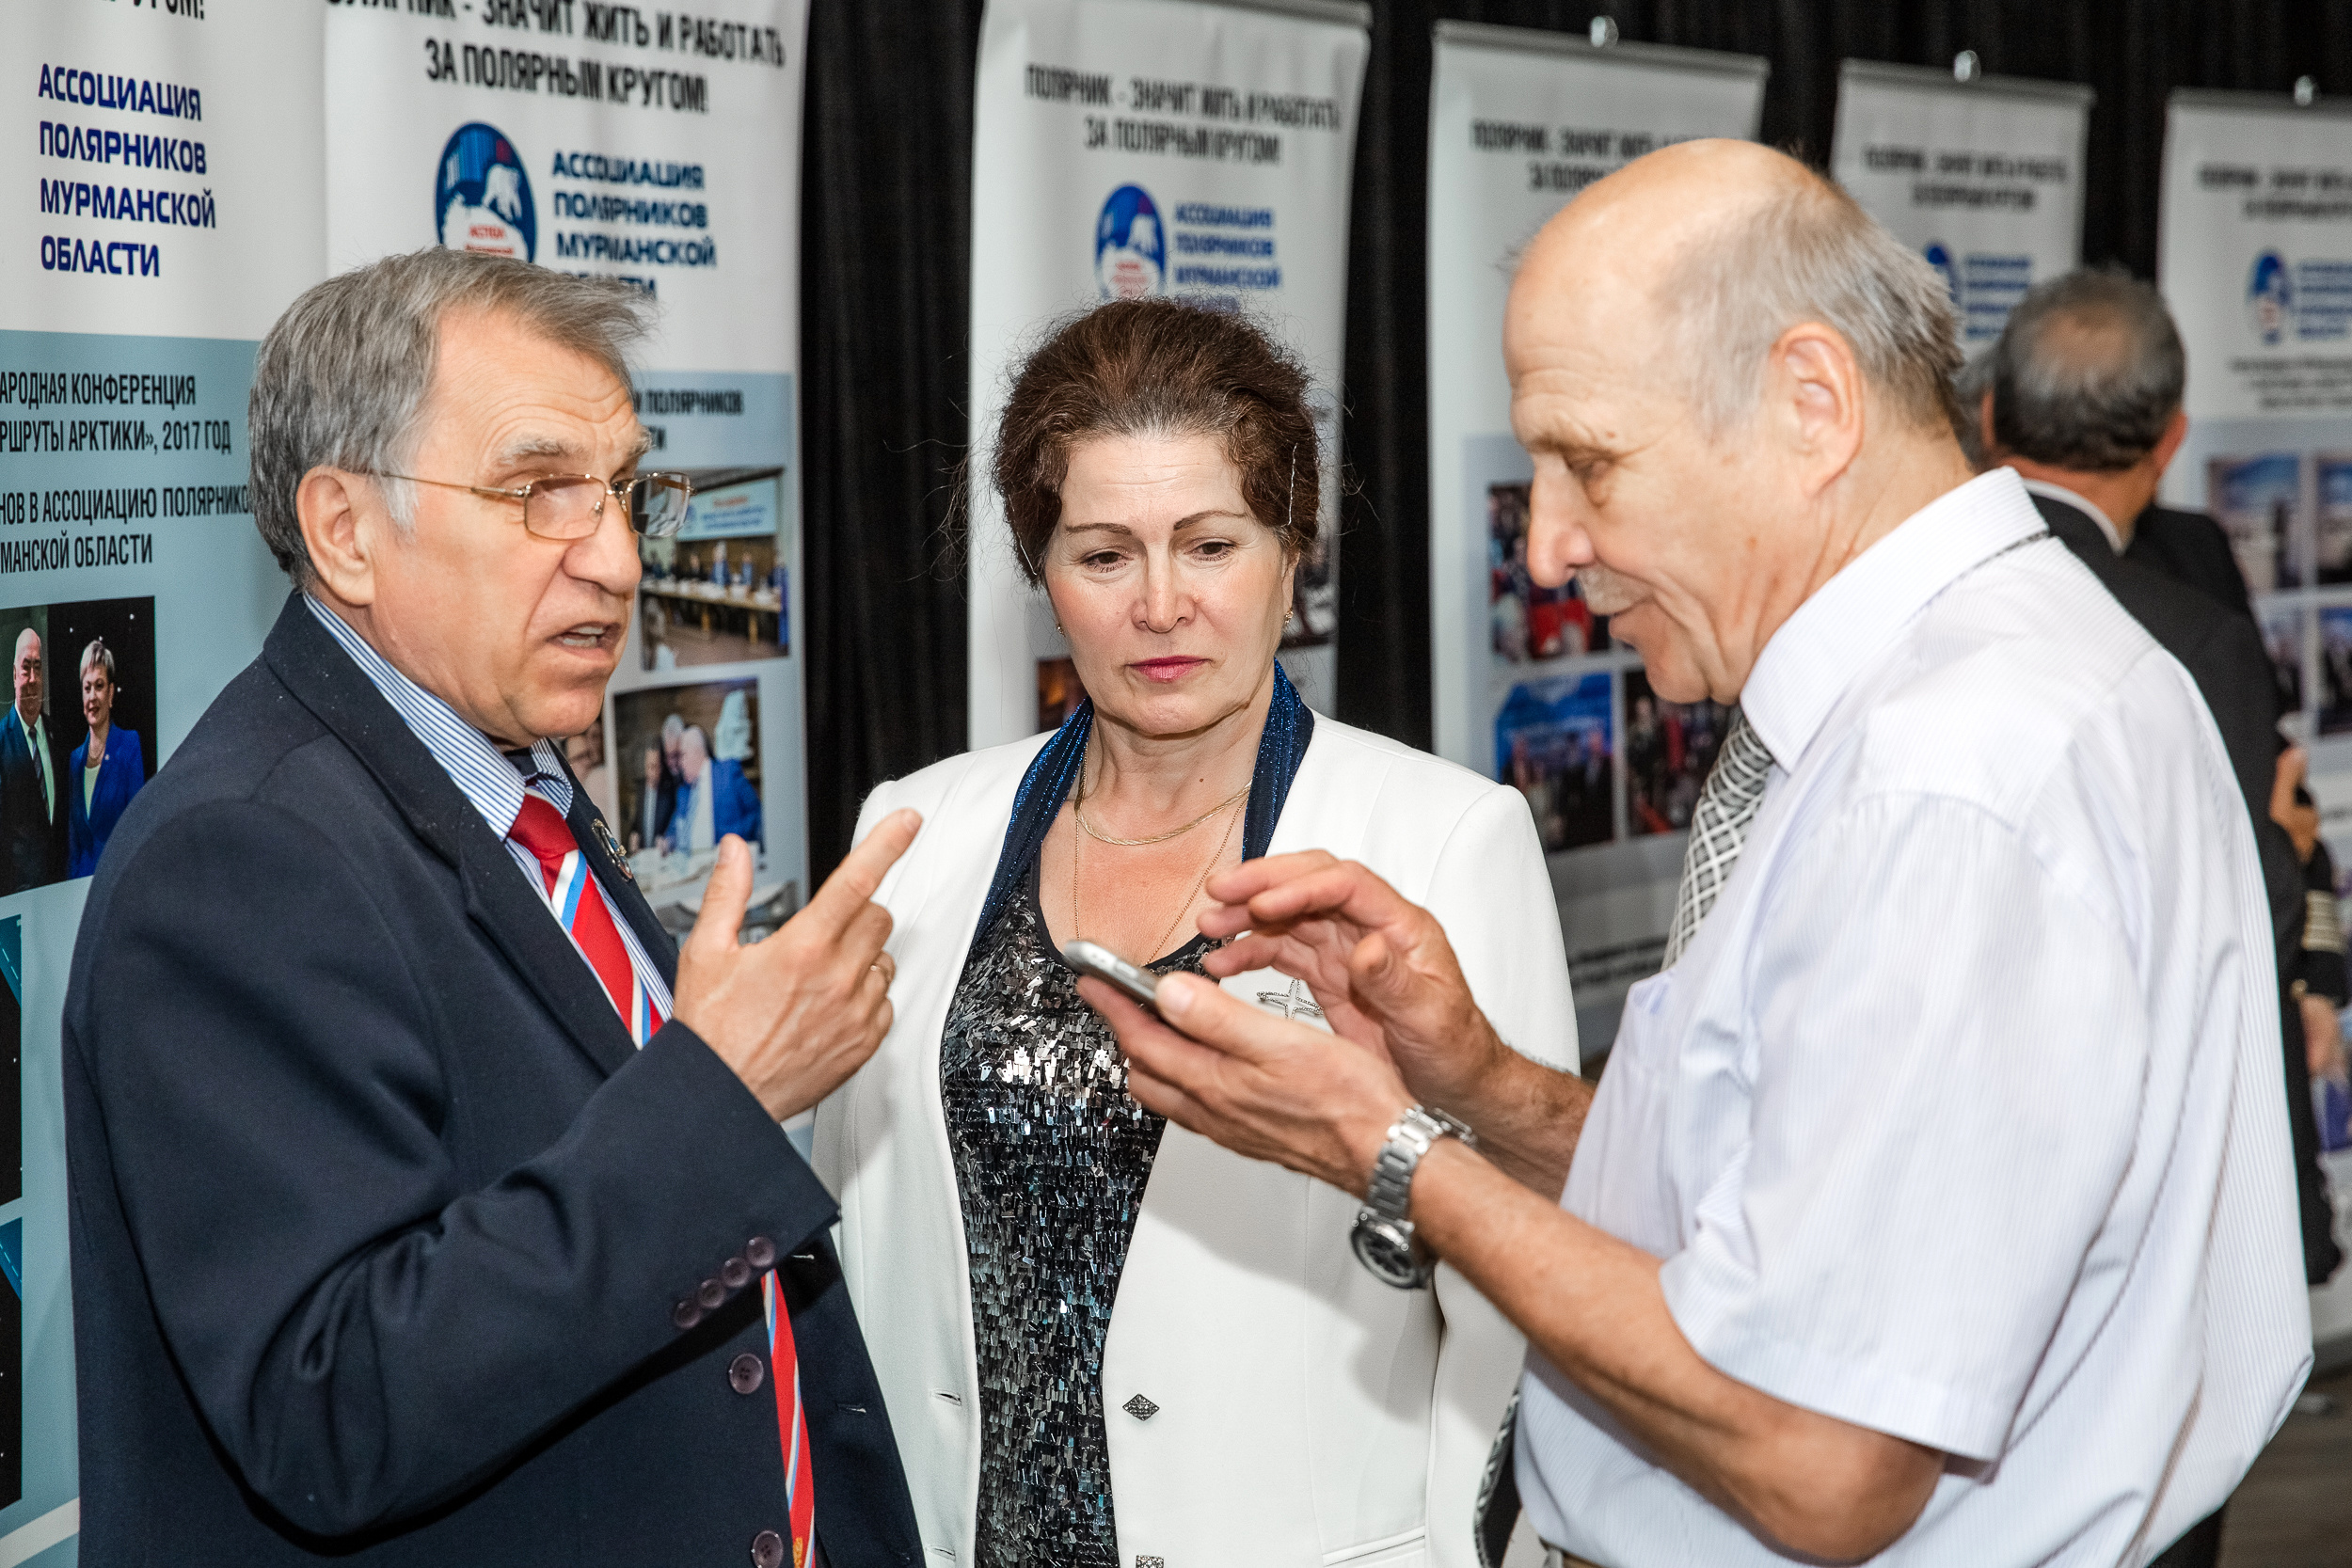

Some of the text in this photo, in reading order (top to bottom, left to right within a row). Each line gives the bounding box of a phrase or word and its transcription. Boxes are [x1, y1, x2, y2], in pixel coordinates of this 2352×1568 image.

[584, 1, 649, 47] ЖИТЬ
[657, 11, 673, 51] И
[677, 14, 786, 69] РАБОТАТЬ
[39, 63, 202, 121] АССОЦИАЦИЯ
[426, 38, 708, 114] ЗА ПОЛЯРНЫМ КРУГОМ!
[40, 120, 207, 175] ПОЛЯРНИКОВ
[552, 150, 705, 190] АССОЦИАЦИЯ
[40, 178, 216, 229] МУРМАНСКОЙ
[554, 191, 707, 229] ПОЛЯРНИКОВ
[40, 235, 160, 277] ОБЛАСТИ
[557, 231, 717, 268] МУРМАНСКОЙ
[0, 372, 196, 410] АРОДНАЯ КОНФЕРЕНЦИЯ
[0, 420, 231, 454] РШРУТЫ АРКТИКИ», 2017 ГОД
[29, 491, 39, 523] В
[42, 487, 157, 525] АССОЦИАЦИЮ
[0, 530, 152, 575] МАНСКОЙ ОБЛАСТИ
